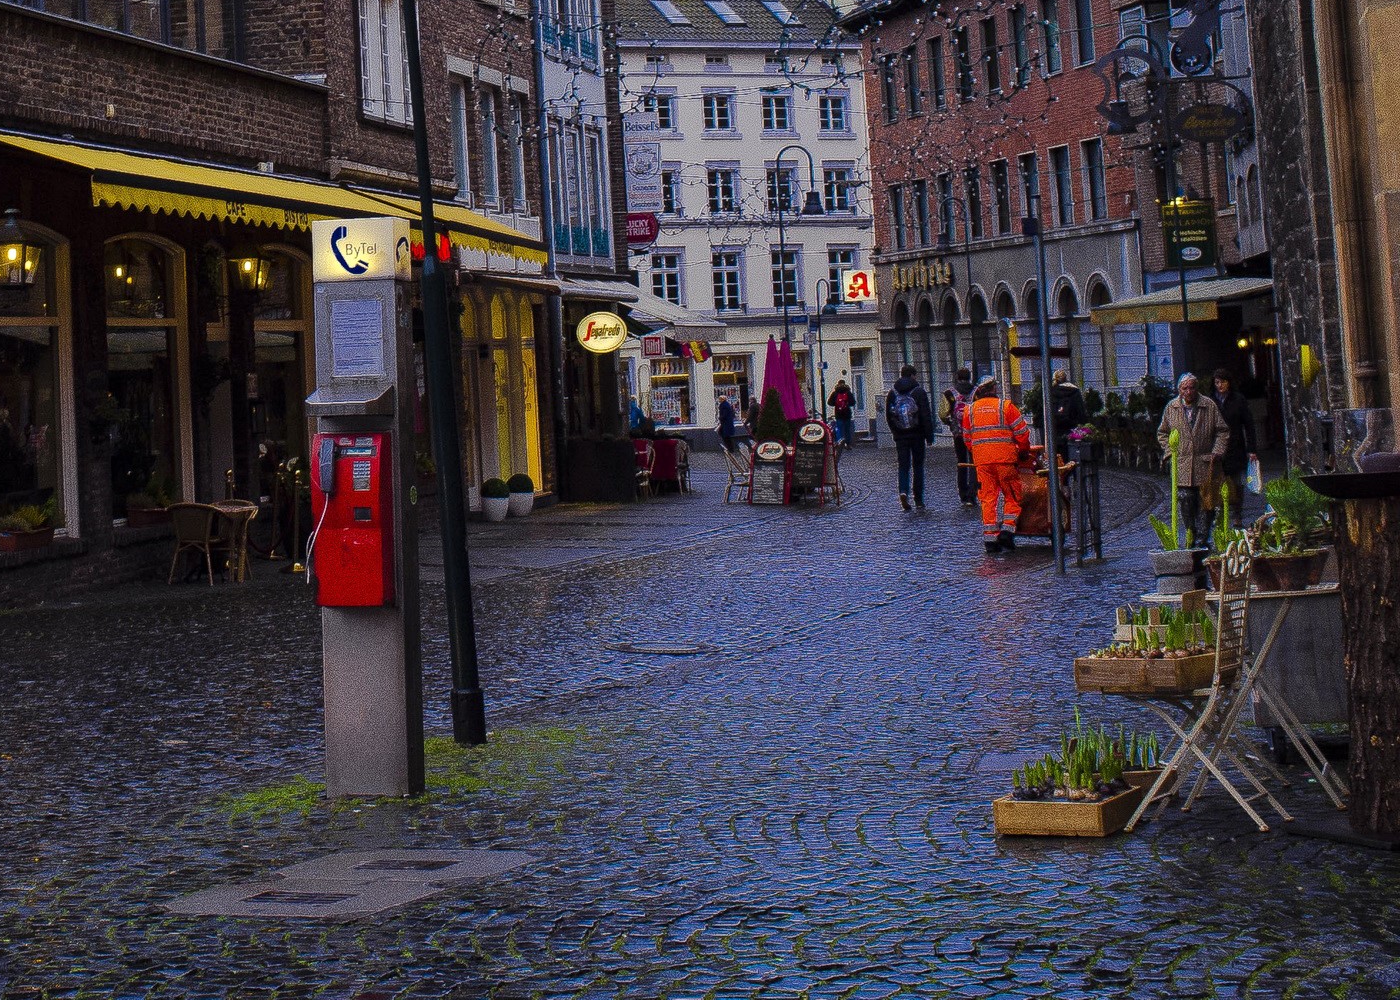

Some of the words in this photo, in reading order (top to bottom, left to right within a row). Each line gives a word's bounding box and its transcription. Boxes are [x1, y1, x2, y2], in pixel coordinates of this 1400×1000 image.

[625, 121, 660, 132] Beissel's
[284, 210, 309, 225] BISTRO
[345, 242, 377, 258] ByTel
[846, 271, 871, 299] A
[583, 321, 620, 341] Segafredo
[645, 337, 661, 355] Bild
